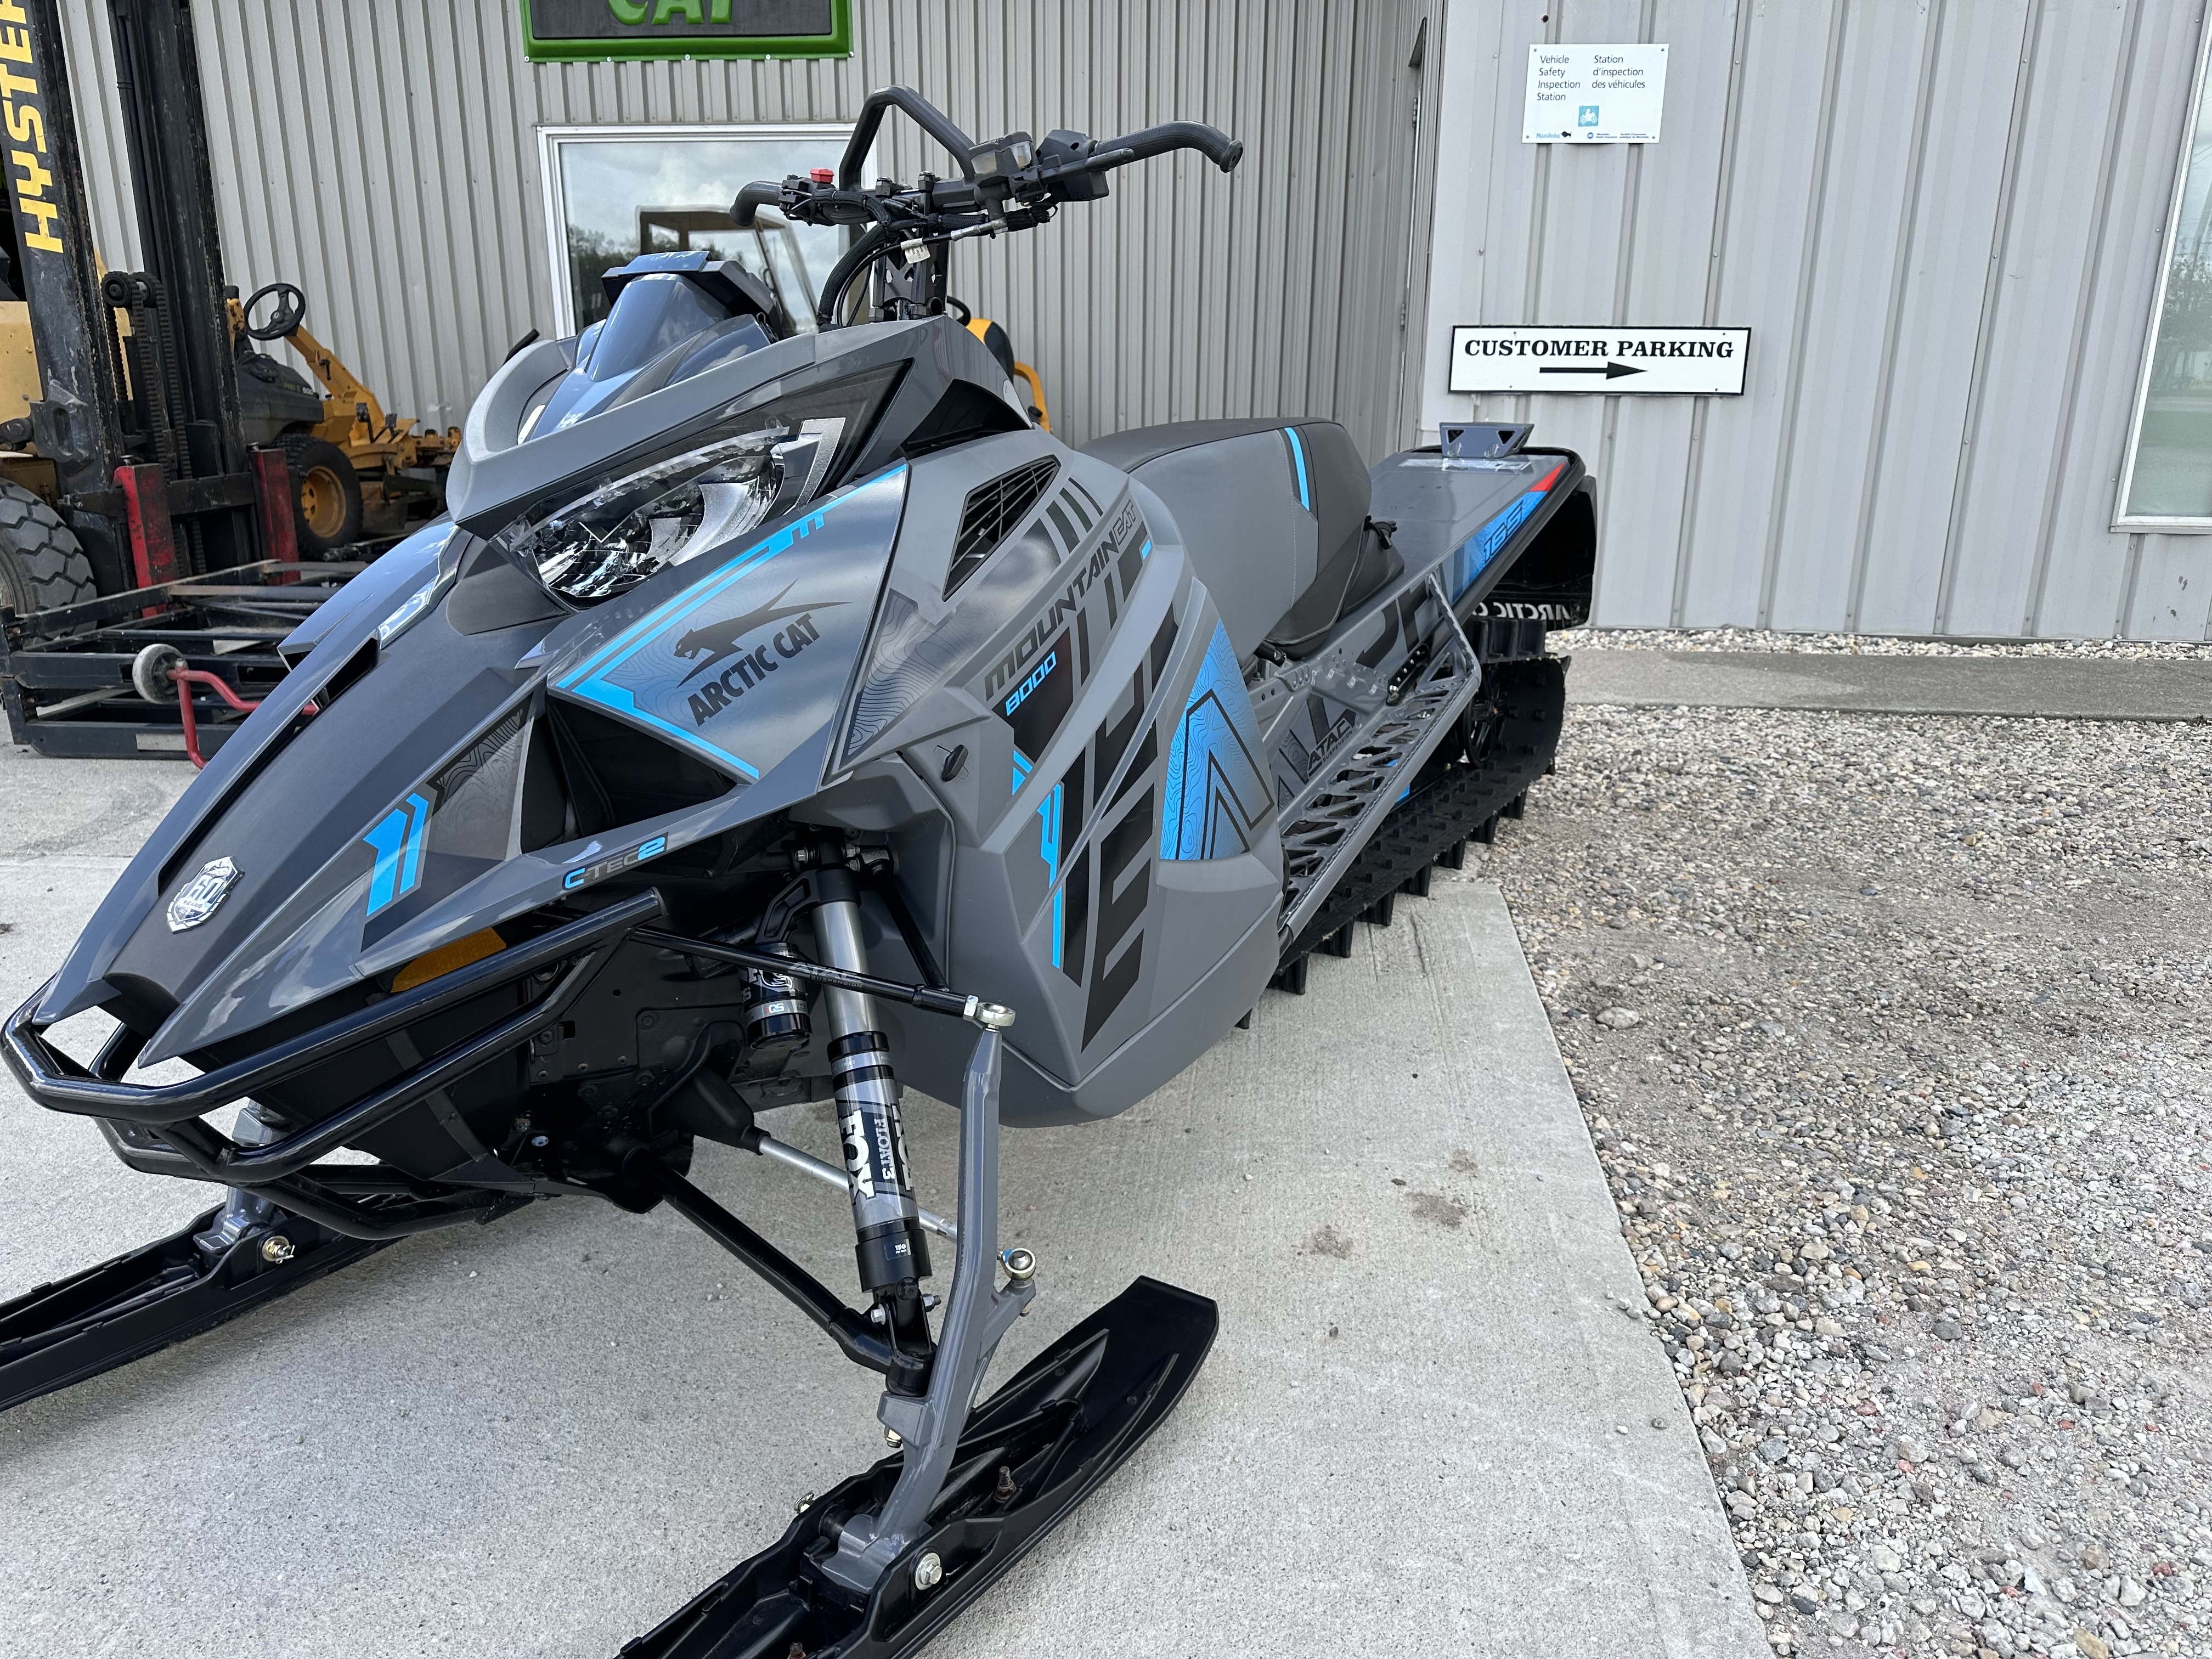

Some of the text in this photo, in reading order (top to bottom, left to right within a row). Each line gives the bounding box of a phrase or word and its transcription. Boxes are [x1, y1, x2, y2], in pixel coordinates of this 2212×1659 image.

[1539, 55, 1570, 64] Vehicle
[1594, 55, 1623, 64] Station
[1538, 67, 1566, 78] Safety
[1593, 67, 1644, 78] d'inspection
[1538, 80, 1581, 90] Inspection
[1592, 80, 1645, 88] des véhicules
[1537, 92, 1566, 101] Station
[1464, 340, 1734, 358] CUSTOMER PARKING
[1483, 499, 1523, 564] 165
[687, 612, 821, 727] ARCTIC CAT
[1006, 651, 1057, 716] 8000
[1308, 719, 1351, 771] ATAC
[1323, 730, 1353, 763] SUSPENSION
[564, 836, 666, 890] C-TEC2
[811, 976, 863, 988] SUSPENSION
[874, 1118, 894, 1167] FLOAT
[839, 1109, 877, 1205] FOX
